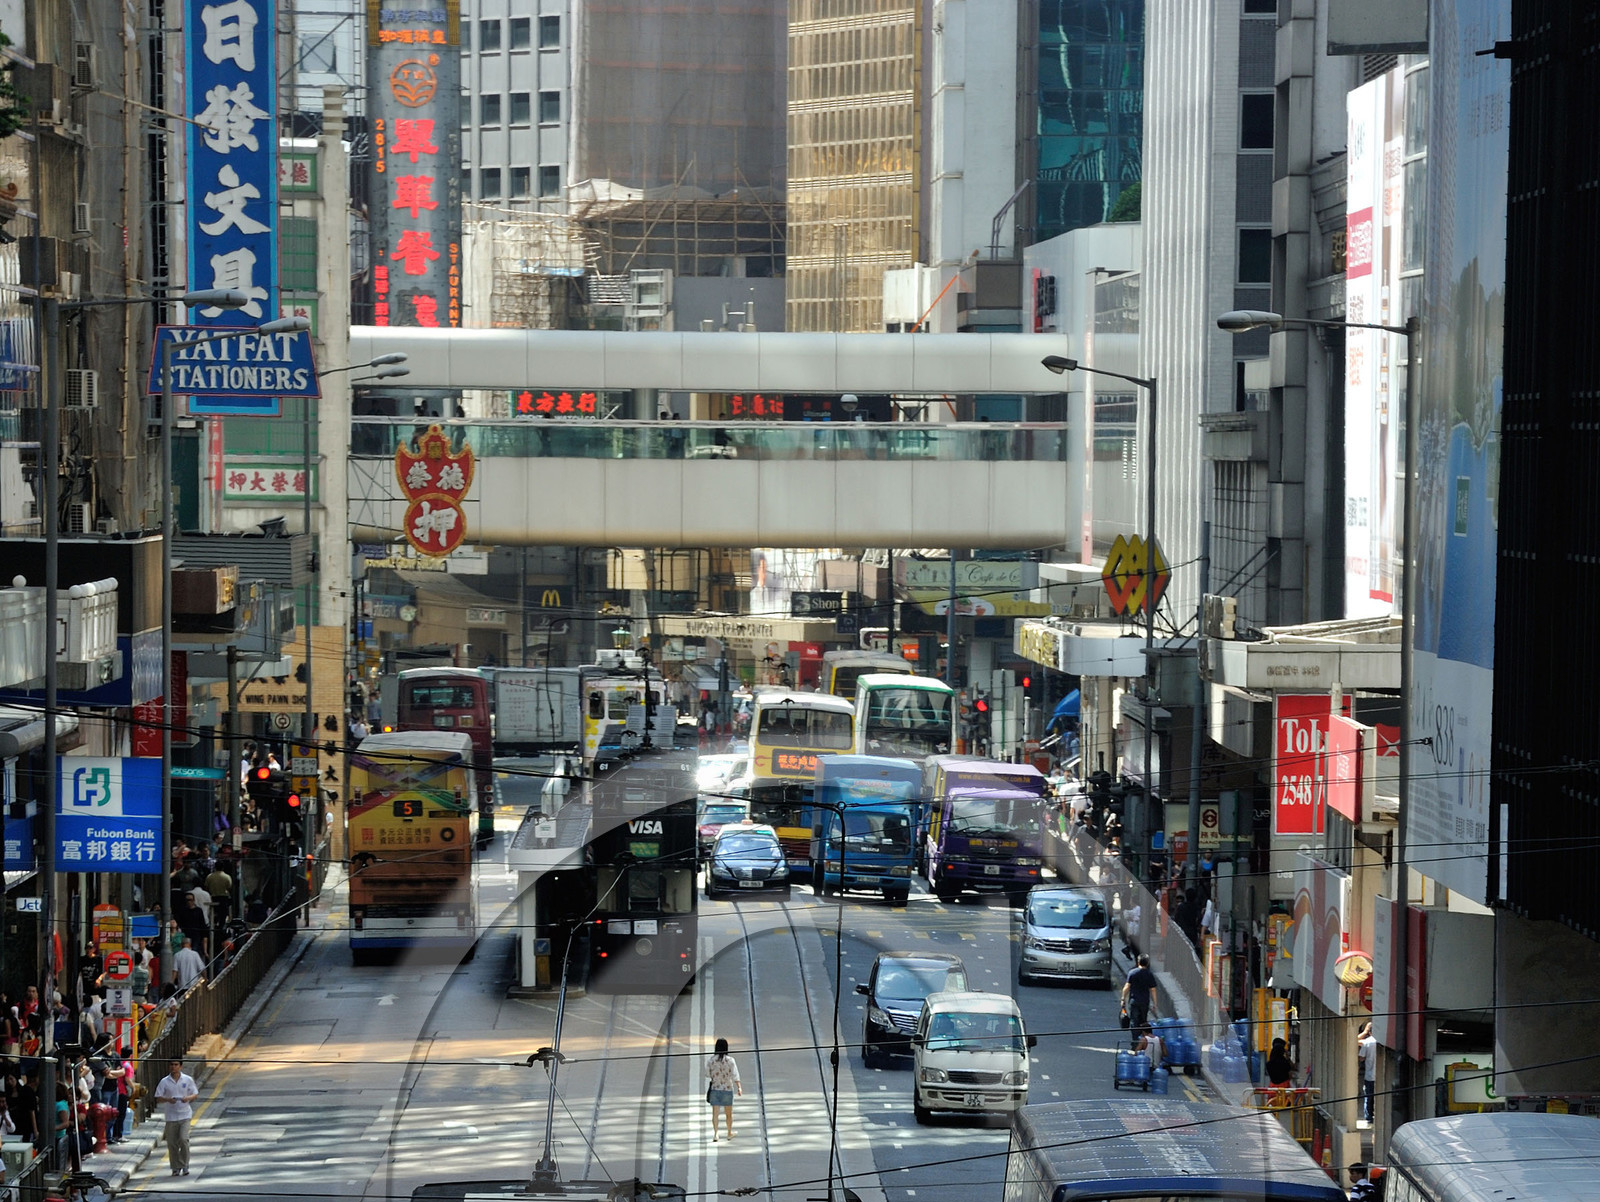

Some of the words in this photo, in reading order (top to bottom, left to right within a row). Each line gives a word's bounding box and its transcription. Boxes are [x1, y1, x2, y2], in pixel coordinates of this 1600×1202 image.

[194, 0, 271, 319] 日發文具
[169, 329, 236, 361] YAT
[236, 330, 299, 363] FAT
[158, 364, 310, 390] STATIONERS
[413, 501, 458, 547] 押
[812, 597, 839, 611] Shop
[246, 694, 264, 705] WING
[267, 694, 289, 705] PAWN
[292, 694, 308, 706] SHO
[1281, 775, 1312, 805] 2548
[403, 802, 413, 815] 5
[87, 828, 124, 839] Fubon
[125, 829, 155, 840] Bank
[628, 821, 664, 834] VISA
[62, 840, 156, 862] 富邦銀行
[681, 964, 691, 972] 61
